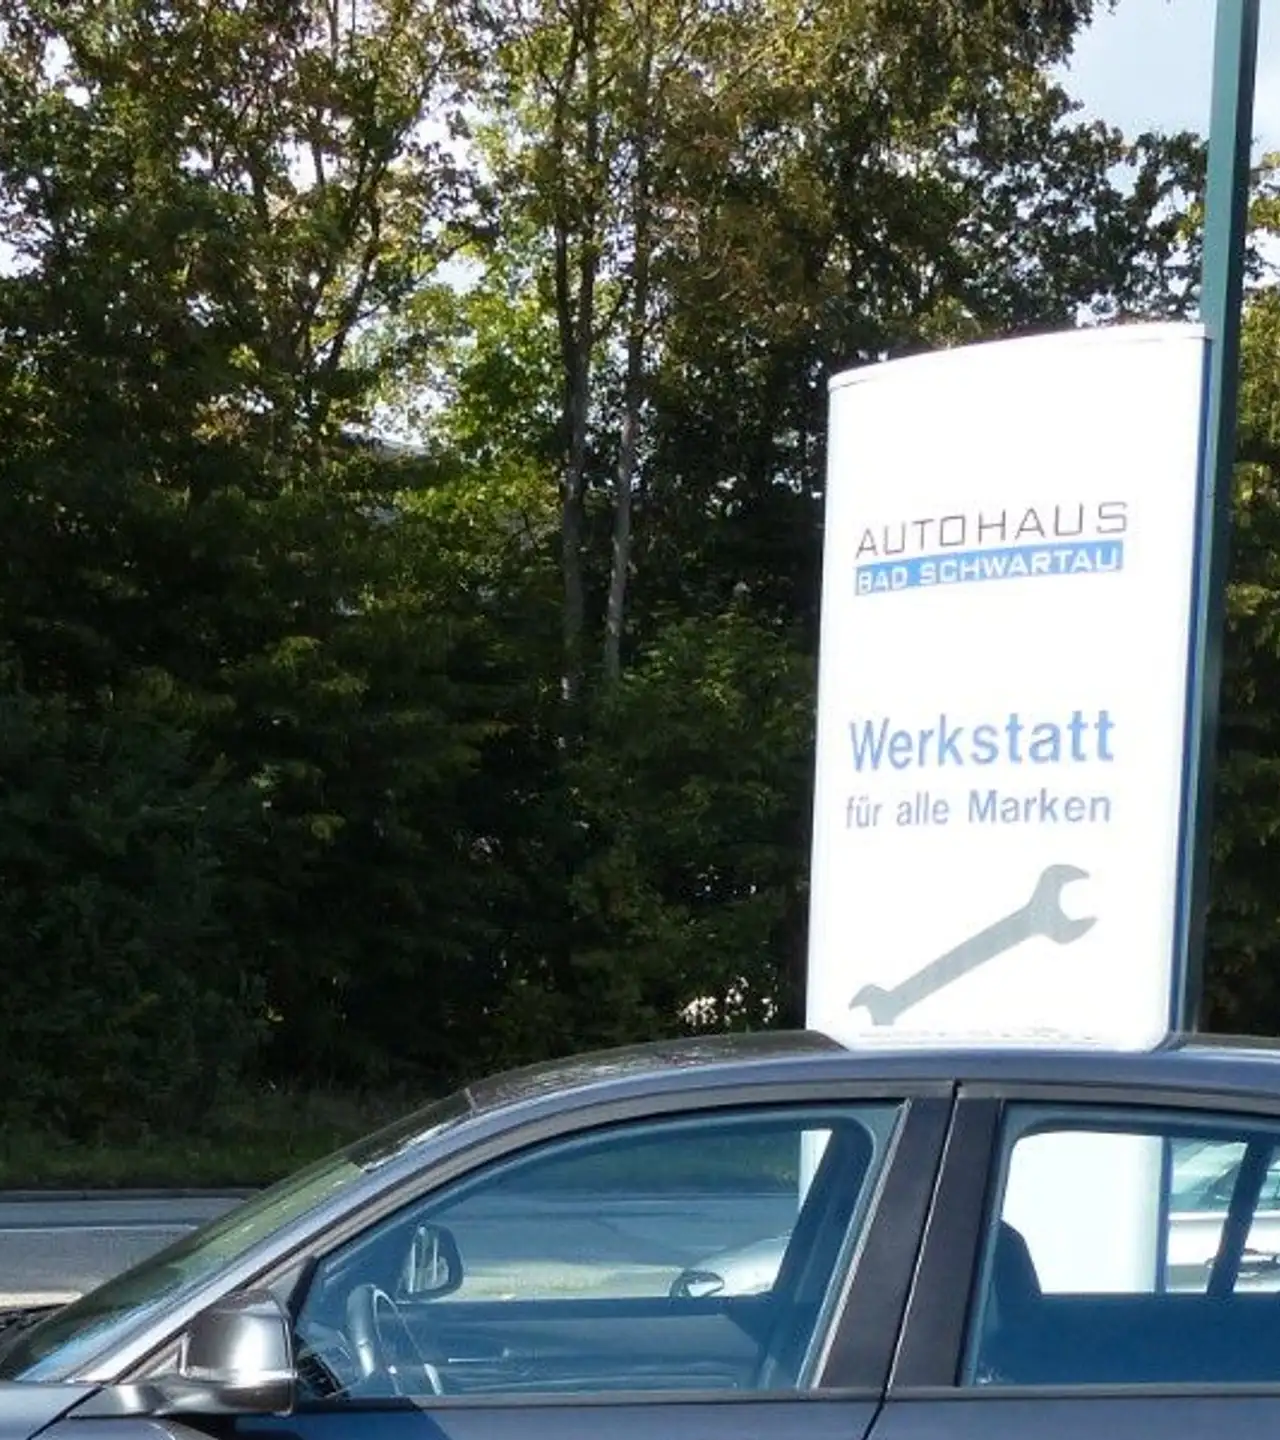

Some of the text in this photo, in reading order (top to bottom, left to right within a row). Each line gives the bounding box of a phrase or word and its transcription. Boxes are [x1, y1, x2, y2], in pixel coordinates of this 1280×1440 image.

[855, 501, 1128, 558] AUTOHAUS
[858, 546, 1119, 595] BAD SCHWARTAU
[849, 709, 1116, 773] Werkstatt
[845, 788, 1112, 829] für alle Marken
